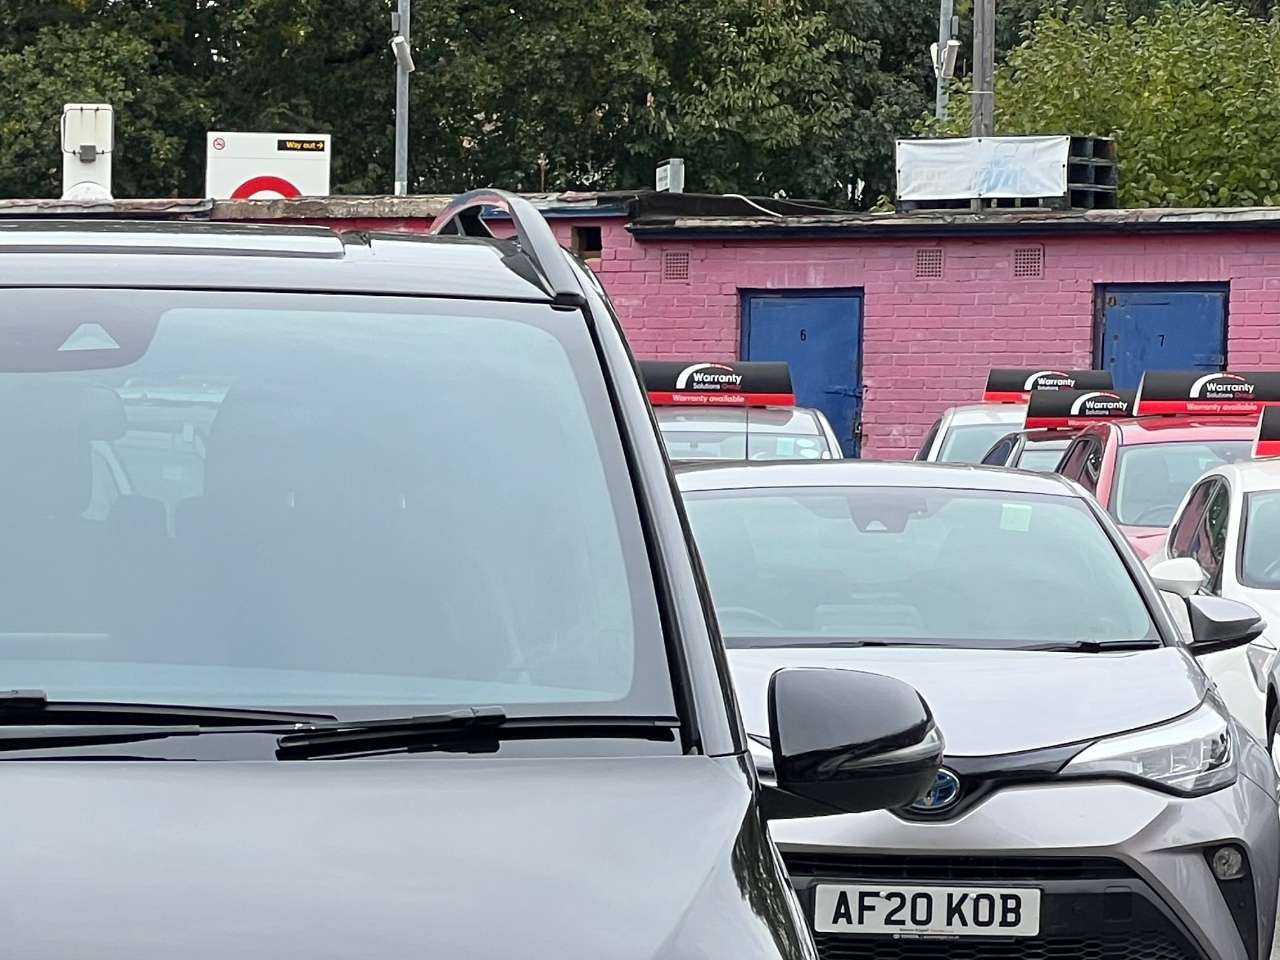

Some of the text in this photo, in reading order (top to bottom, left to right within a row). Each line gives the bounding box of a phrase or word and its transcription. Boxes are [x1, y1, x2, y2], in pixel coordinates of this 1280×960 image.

[286, 141, 301, 149] Way
[800, 328, 807, 342] 6
[1158, 334, 1165, 348] 7
[693, 373, 742, 384] Warranty
[1037, 378, 1075, 387] Warranty
[1206, 383, 1254, 393] Warranty
[672, 394, 745, 404] Warranty available
[1085, 400, 1128, 411] Warranty
[1186, 402, 1258, 412] Warranty available
[831, 890, 1022, 928] AF20 KOB
